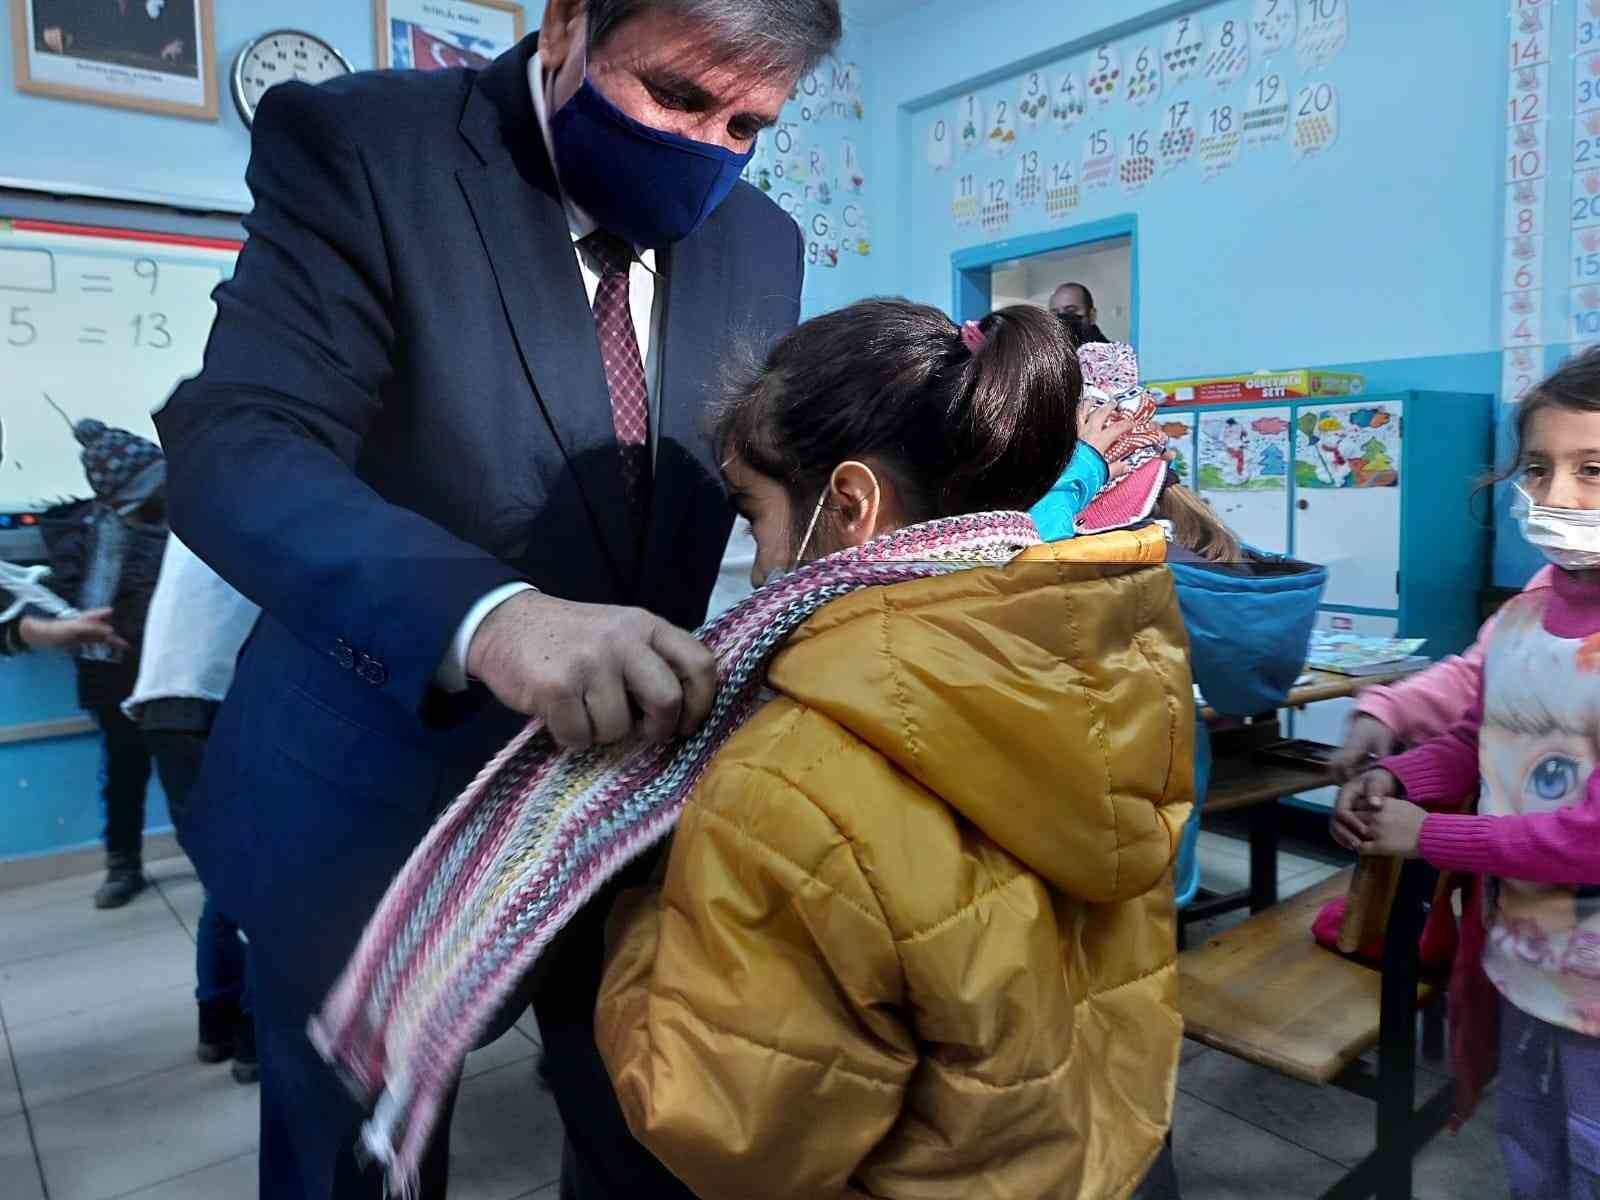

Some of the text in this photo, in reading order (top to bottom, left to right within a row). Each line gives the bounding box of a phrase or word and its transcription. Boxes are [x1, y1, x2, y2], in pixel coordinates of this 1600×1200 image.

[1579, 22, 1600, 45] 3
[967, 95, 974, 117] 1
[996, 100, 1007, 124] 2
[1028, 72, 1039, 96] 3
[1061, 73, 1074, 94] 4
[1098, 45, 1109, 72] 5
[1135, 47, 1149, 73] 6
[1176, 17, 1190, 46] 7
[1220, 20, 1234, 48] 8
[1308, 0, 1337, 22] 10
[1511, 36, 1542, 65] 14
[832, 62, 849, 89] M
[832, 102, 847, 119] m
[1509, 94, 1538, 122] 12
[960, 74, 1332, 202] 11 12 13 14 15 16 17 18 19 20
[811, 151, 821, 176] R
[1509, 150, 1540, 179] 10
[812, 213, 828, 237] G
[1517, 208, 1532, 234] 8
[808, 241, 818, 265] g
[134, 256, 158, 296] 9
[1514, 263, 1533, 289] 6
[8, 306, 38, 347] 5
[131, 312, 172, 349] 13
[1512, 319, 1532, 342] 4
[1514, 374, 1531, 400] 2
